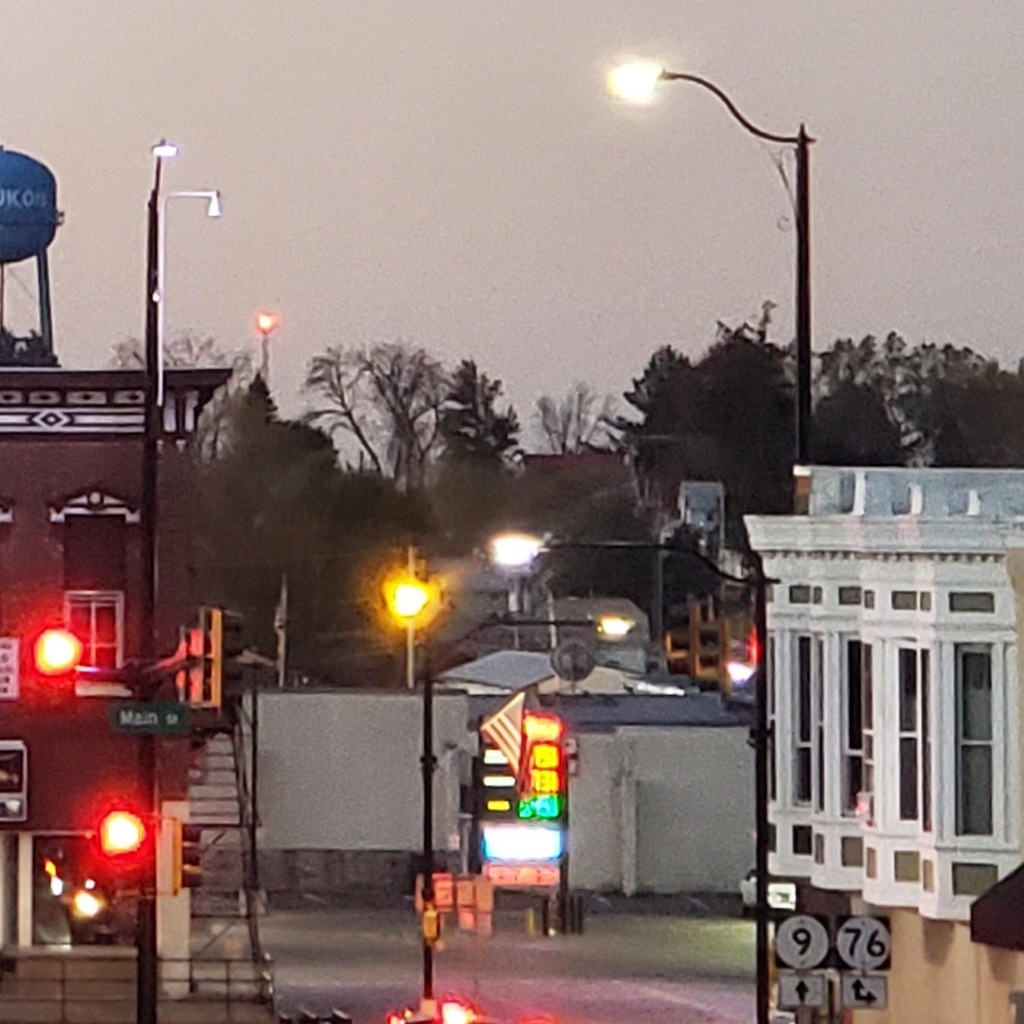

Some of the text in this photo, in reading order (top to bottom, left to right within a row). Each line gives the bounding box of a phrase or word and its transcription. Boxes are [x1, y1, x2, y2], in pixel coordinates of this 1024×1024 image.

[119, 709, 158, 726] Main
[792, 927, 812, 956] 9
[844, 927, 886, 958] 76
